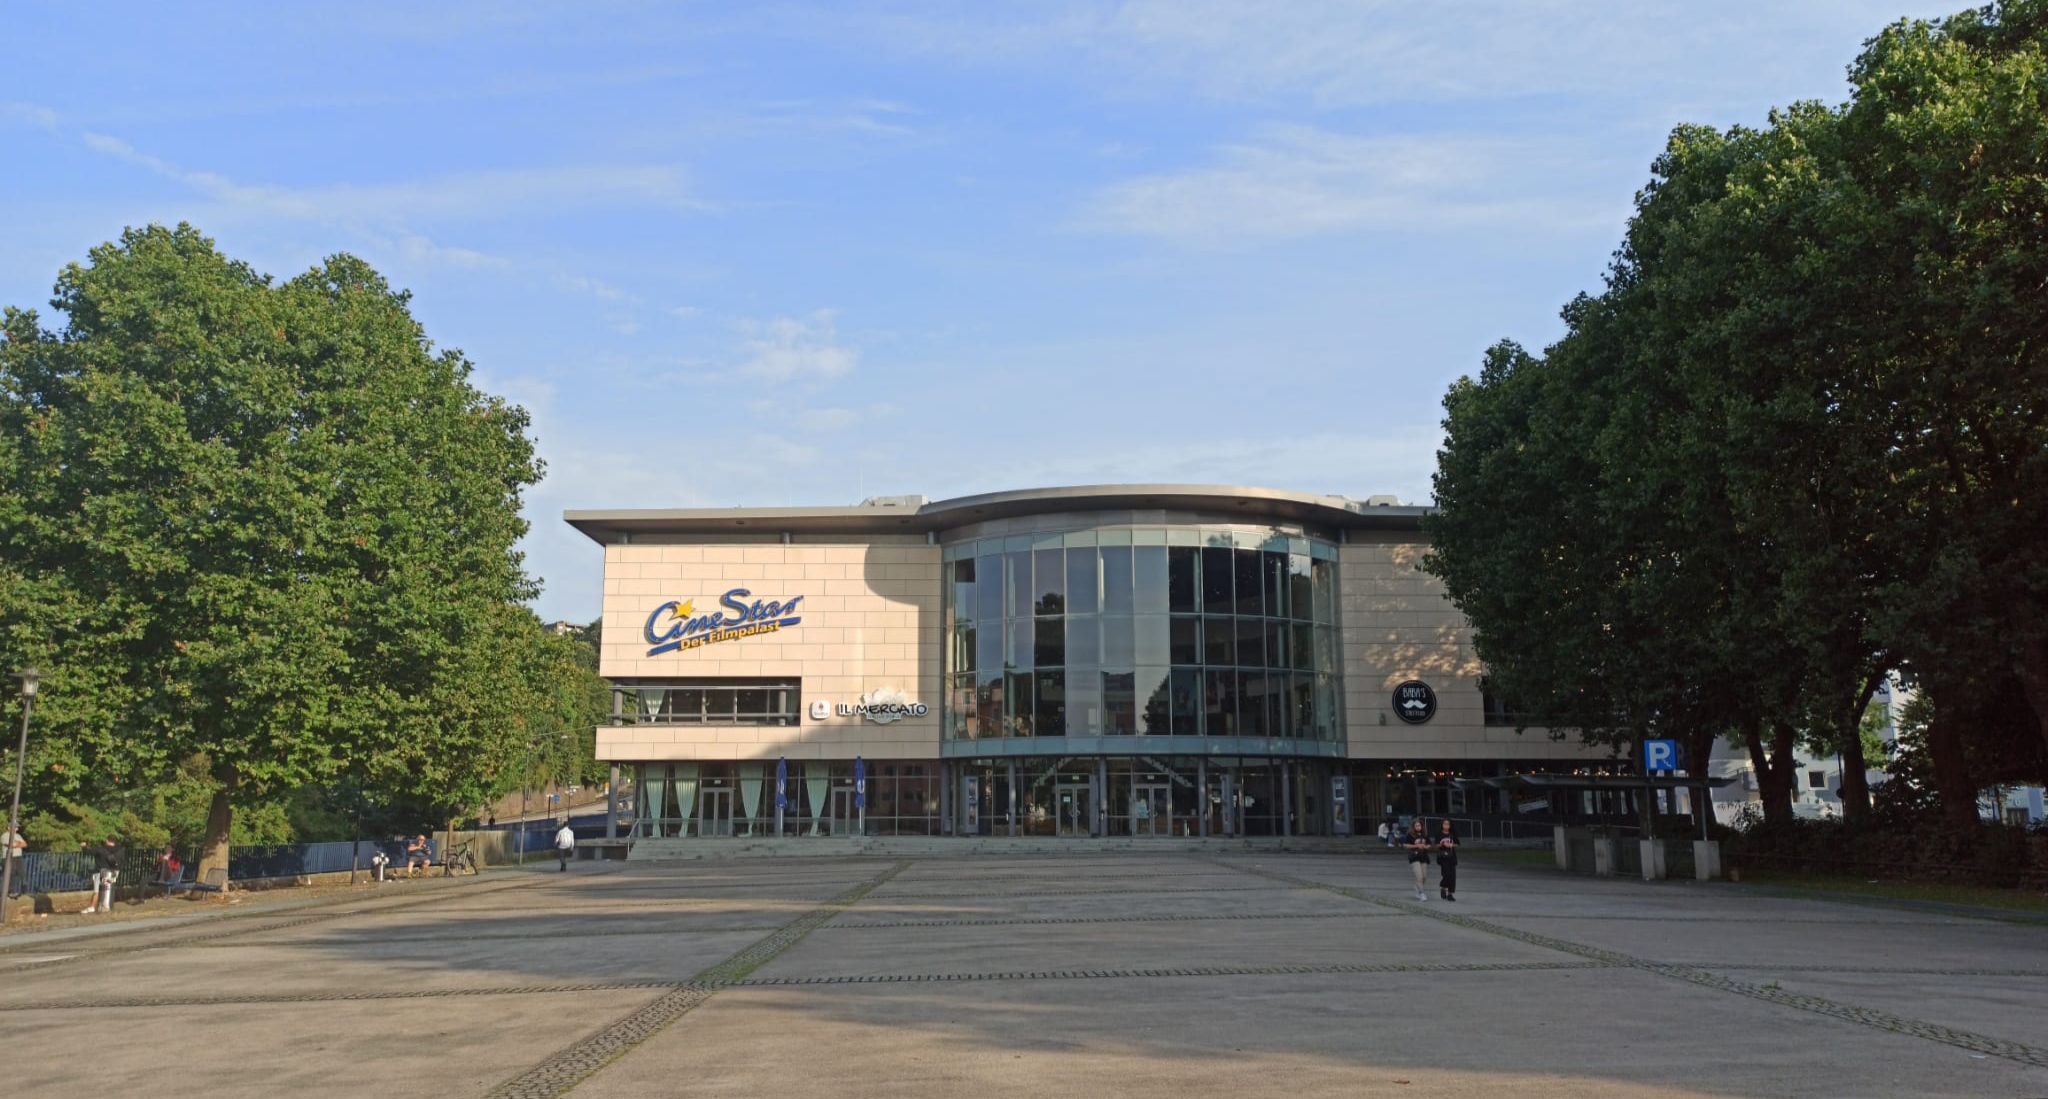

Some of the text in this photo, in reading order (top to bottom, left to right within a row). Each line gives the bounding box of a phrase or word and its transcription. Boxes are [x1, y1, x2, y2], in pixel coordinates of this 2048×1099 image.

[680, 621, 781, 651] Der Filmpalast
[839, 703, 851, 714] IL
[855, 703, 927, 715] MERCATO
[1649, 742, 1670, 769] P
